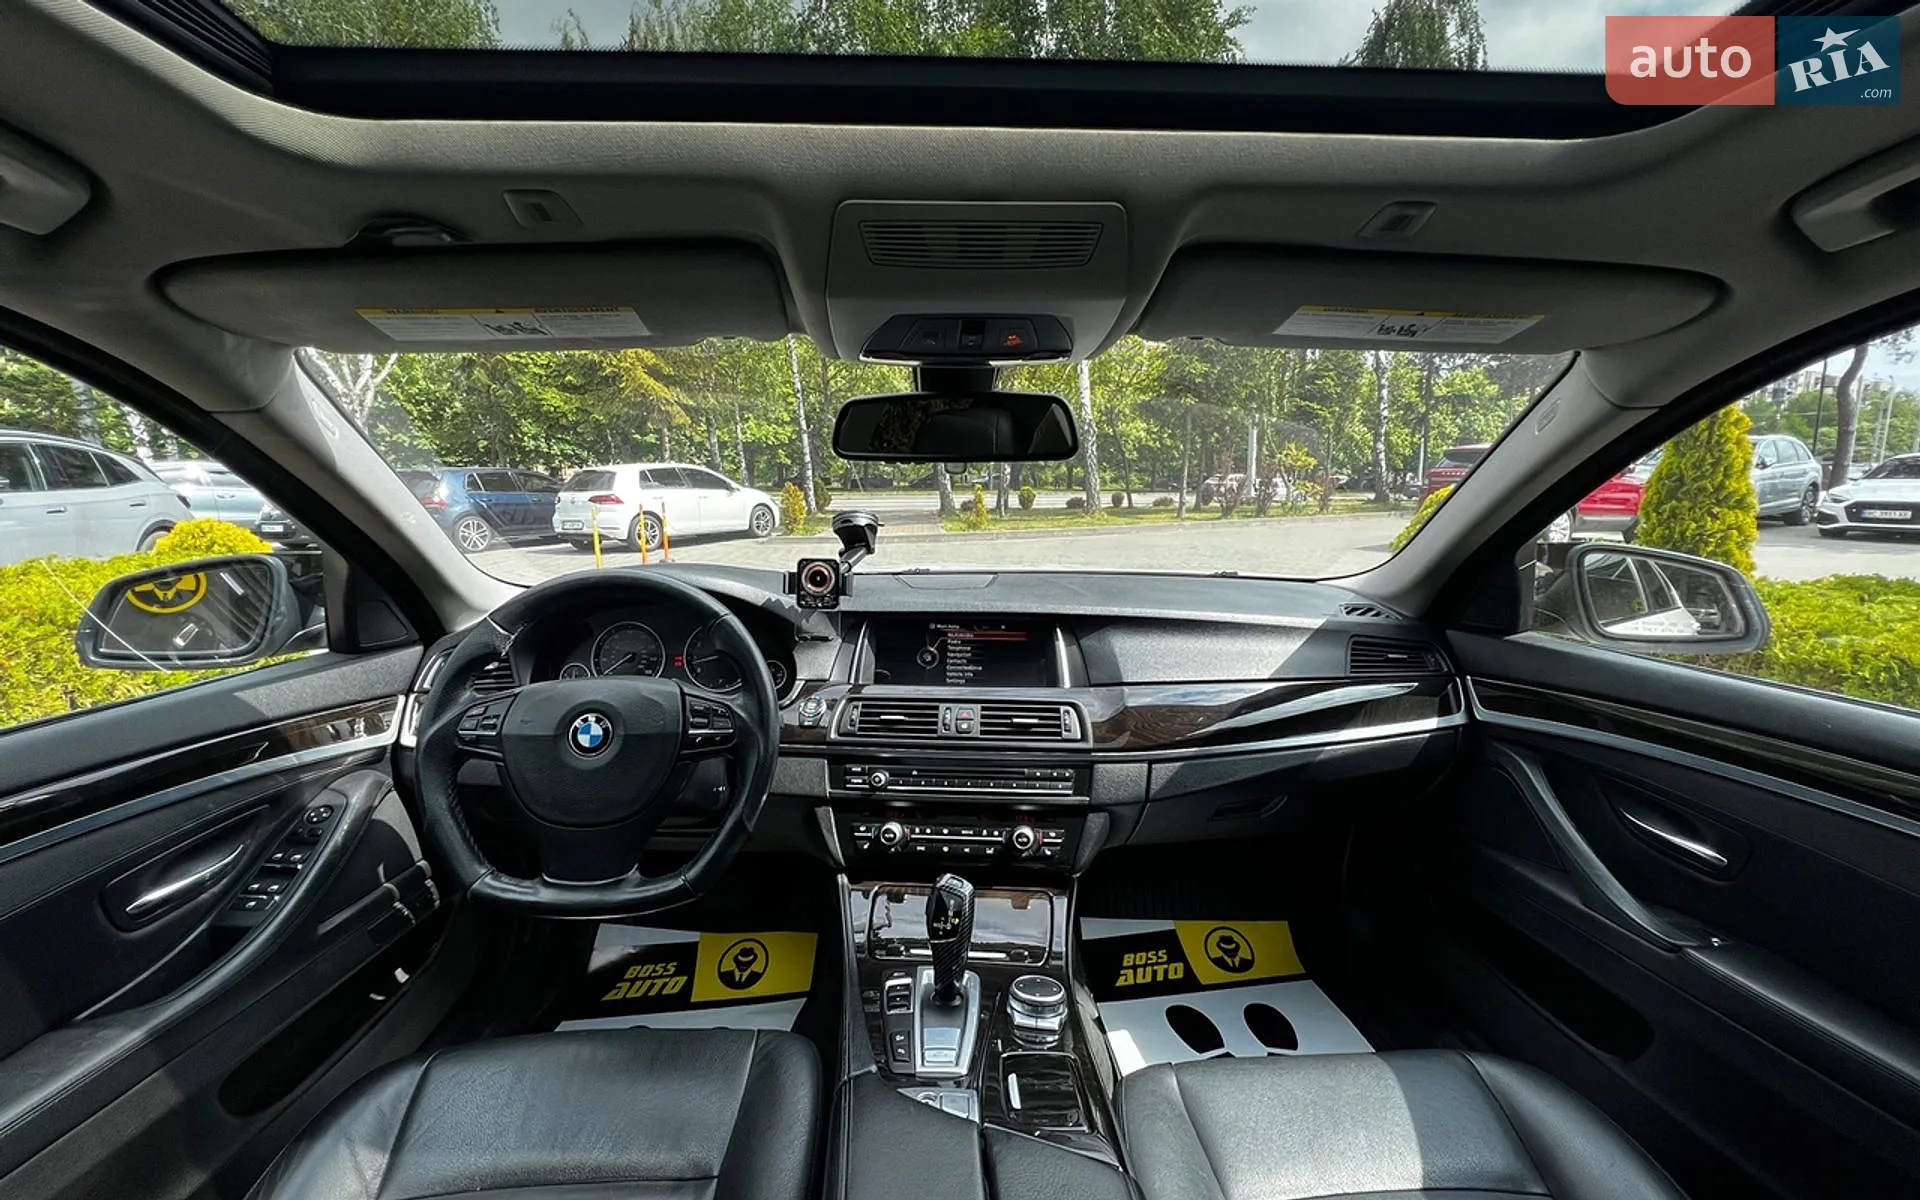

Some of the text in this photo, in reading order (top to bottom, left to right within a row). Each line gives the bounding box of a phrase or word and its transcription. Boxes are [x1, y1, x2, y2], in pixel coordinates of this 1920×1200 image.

[1122, 949, 1168, 967] BOSS
[623, 962, 678, 979] BOSS
[1115, 962, 1184, 987] AUTO
[601, 976, 688, 1001] AUTO
